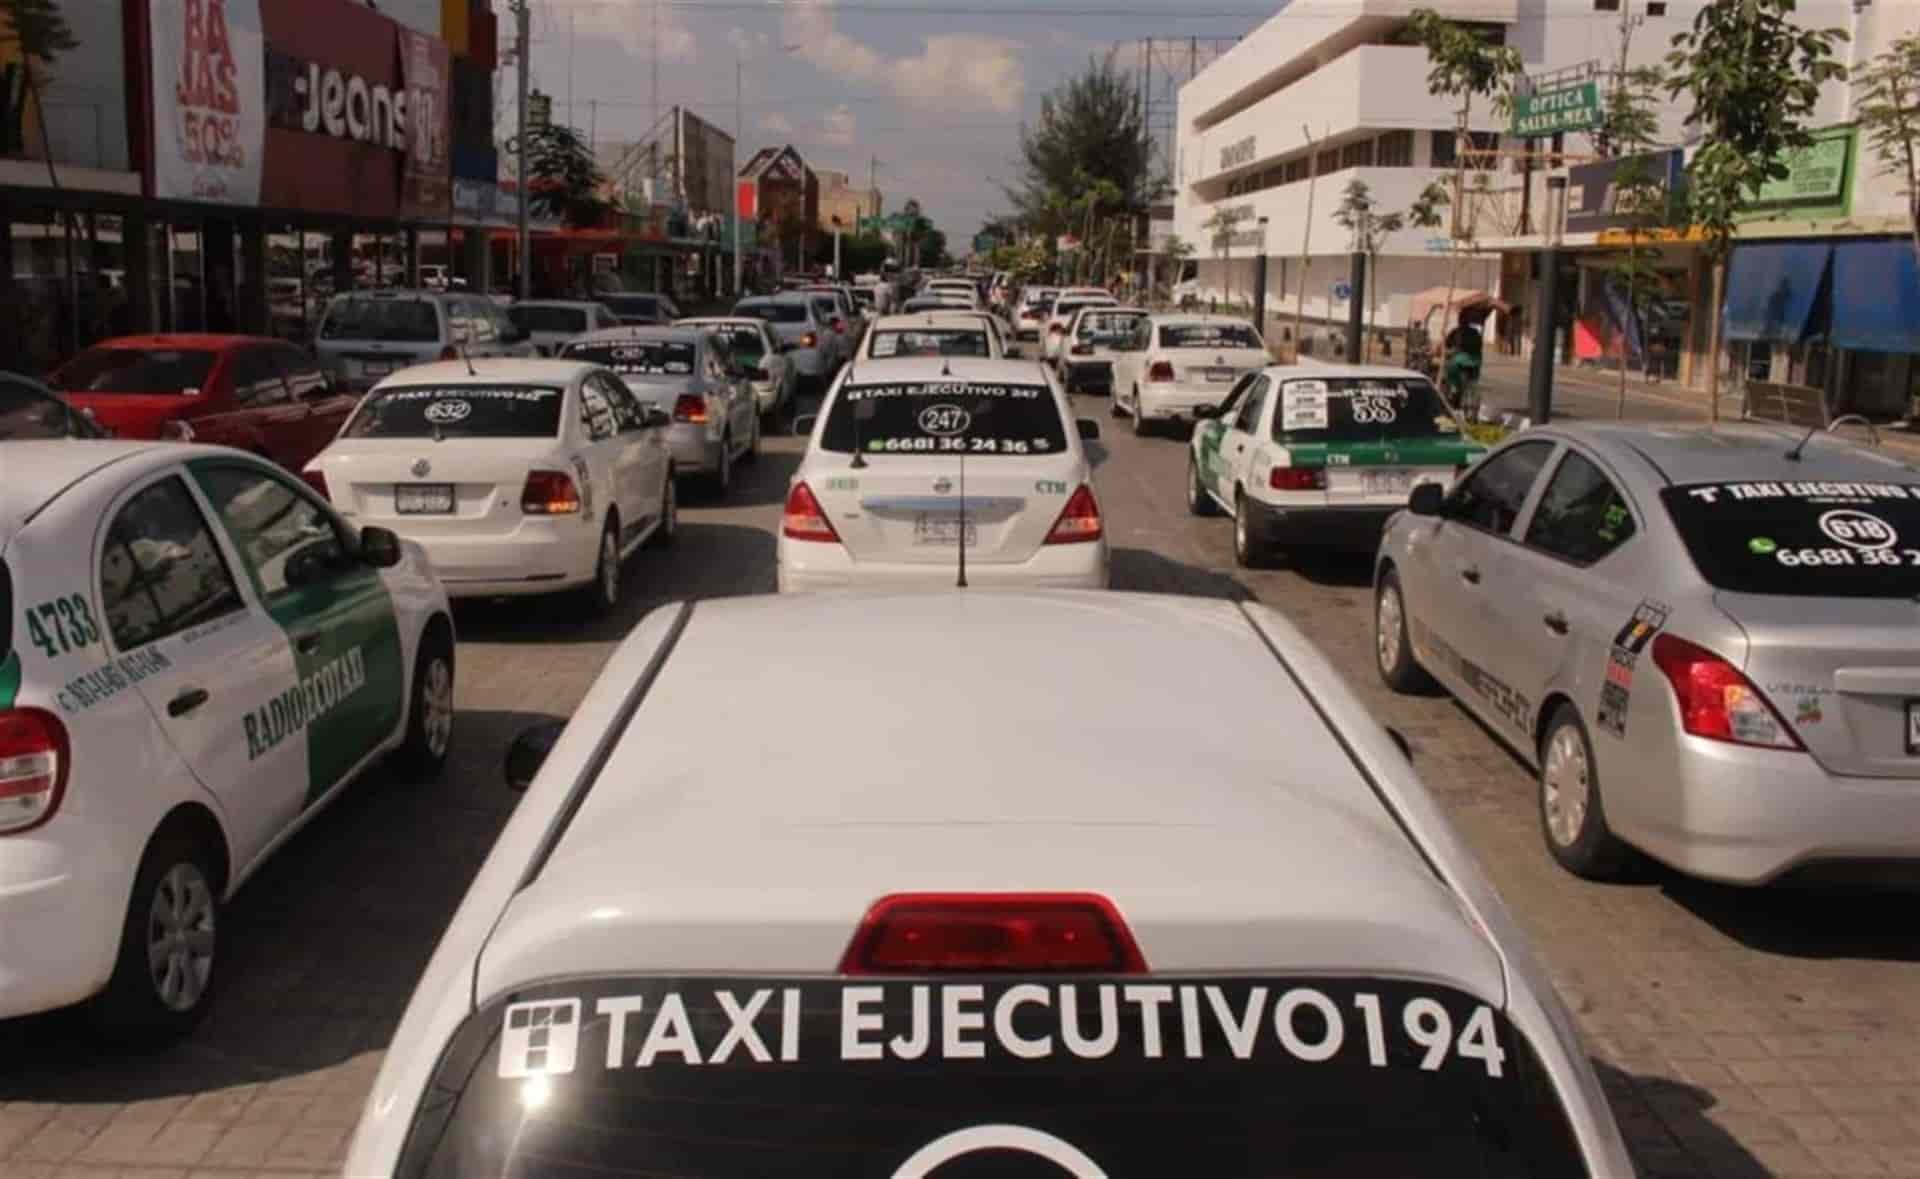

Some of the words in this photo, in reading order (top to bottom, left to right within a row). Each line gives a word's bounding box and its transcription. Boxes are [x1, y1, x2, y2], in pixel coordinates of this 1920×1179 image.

[866, 387, 901, 398] TAXI
[906, 384, 1007, 397] EJECUTIVO
[926, 409, 961, 430] 247
[940, 437, 966, 450] 36
[970, 438, 997, 451] 24
[1001, 438, 1028, 453] 36
[25, 592, 98, 659] 4733
[596, 989, 803, 1069] TAXI
